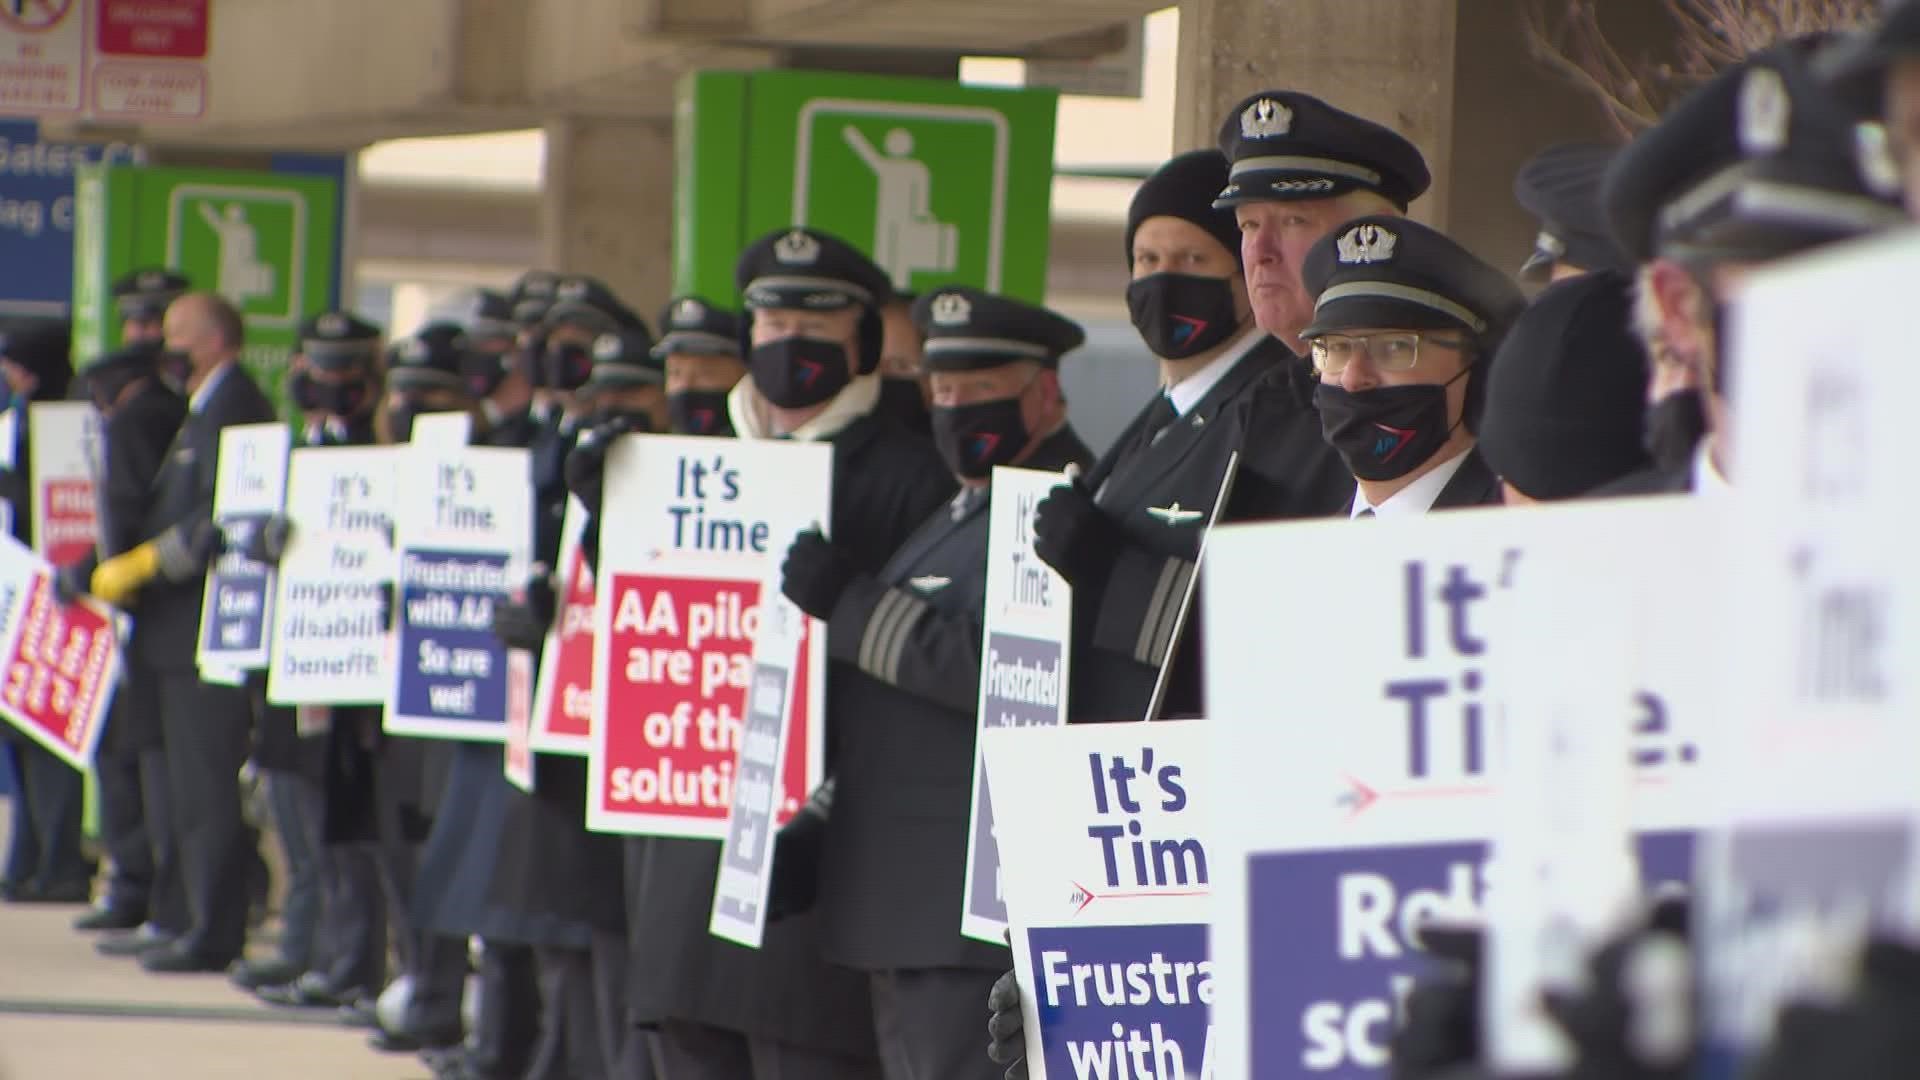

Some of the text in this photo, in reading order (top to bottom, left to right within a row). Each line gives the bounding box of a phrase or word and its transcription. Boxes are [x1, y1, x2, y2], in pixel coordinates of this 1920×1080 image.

[0, 198, 43, 238] ag
[674, 455, 740, 502] It's
[667, 504, 769, 553] Time
[1011, 552, 1053, 609] Time.
[1405, 548, 1523, 660] It'
[409, 594, 456, 624] with
[614, 589, 679, 635] AA
[419, 638, 491, 677] So are
[626, 646, 693, 683] are
[987, 647, 1060, 706] Frustrated
[644, 703, 691, 747] of
[1089, 747, 1187, 814] It's
[1338, 865, 1496, 957] Rel
[1302, 975, 1413, 1070] sc
[1066, 1021, 1186, 1080] with
